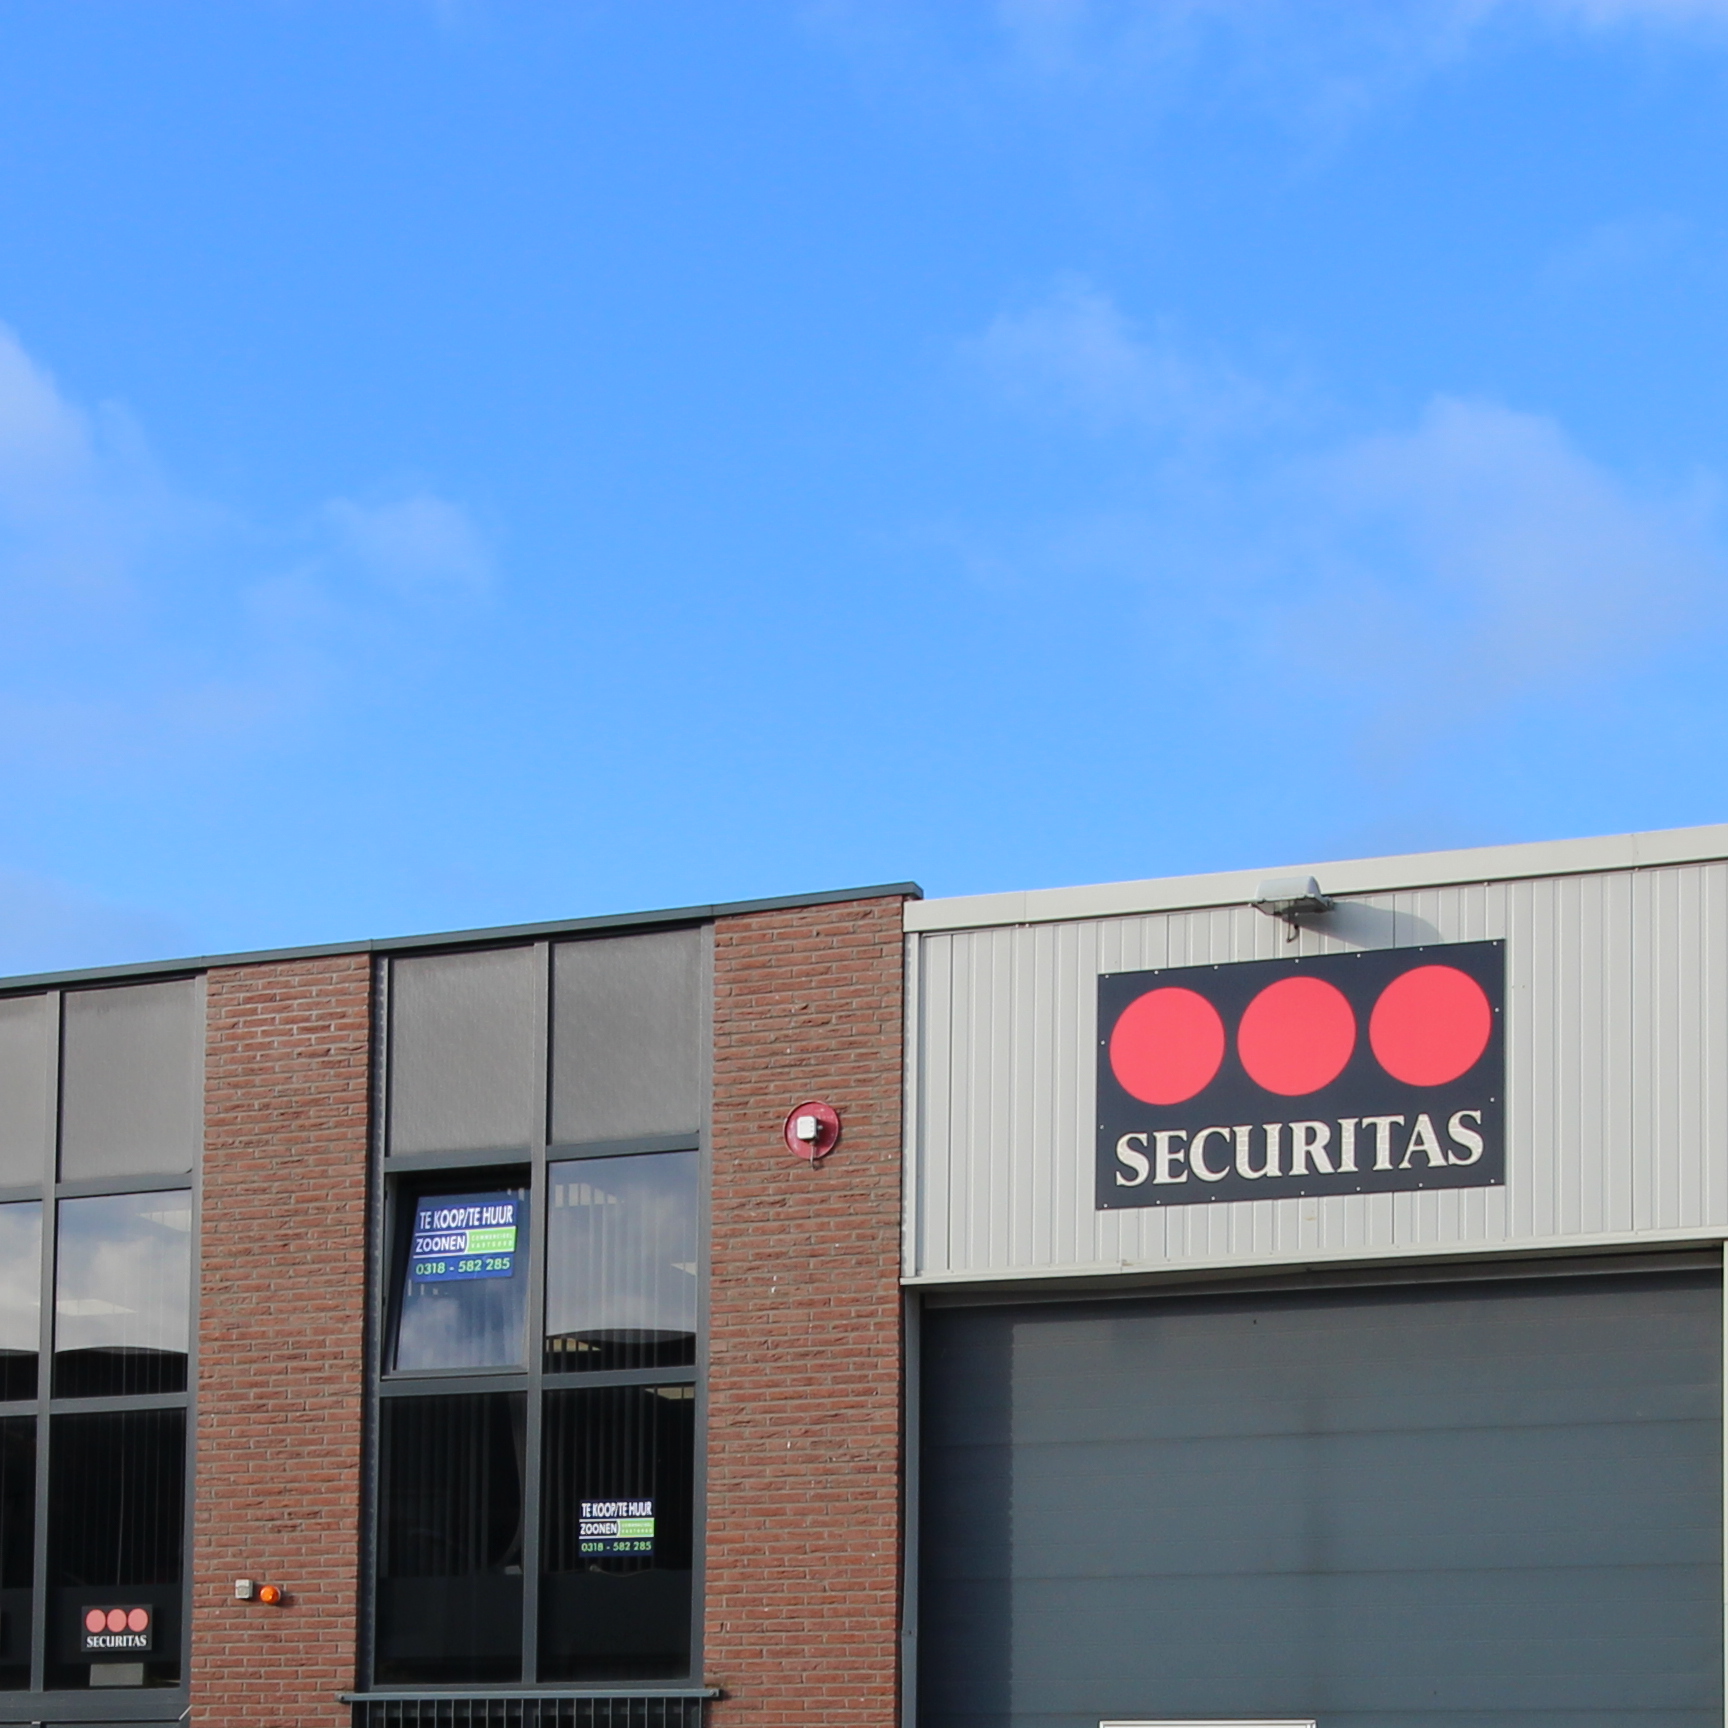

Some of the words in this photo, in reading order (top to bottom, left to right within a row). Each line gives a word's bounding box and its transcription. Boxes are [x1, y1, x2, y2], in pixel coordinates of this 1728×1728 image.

[1115, 1110, 1484, 1187] SECURITAS
[420, 1211, 432, 1230] TE
[433, 1207, 481, 1229] KOOP/TE
[482, 1205, 514, 1225] HUUR
[415, 1235, 466, 1253] ZOONEN
[415, 1262, 446, 1275] 0318
[458, 1259, 482, 1273] 582
[486, 1257, 511, 1270] 285
[581, 1502, 591, 1517] TE
[592, 1502, 627, 1517] KOOP/TE
[628, 1501, 652, 1516] HUUR
[580, 1522, 617, 1535] ZOONEN
[581, 1542, 604, 1552] 0318
[612, 1541, 631, 1551] 582
[633, 1541, 652, 1551] 285
[86, 1635, 147, 1648] SECURITAS
